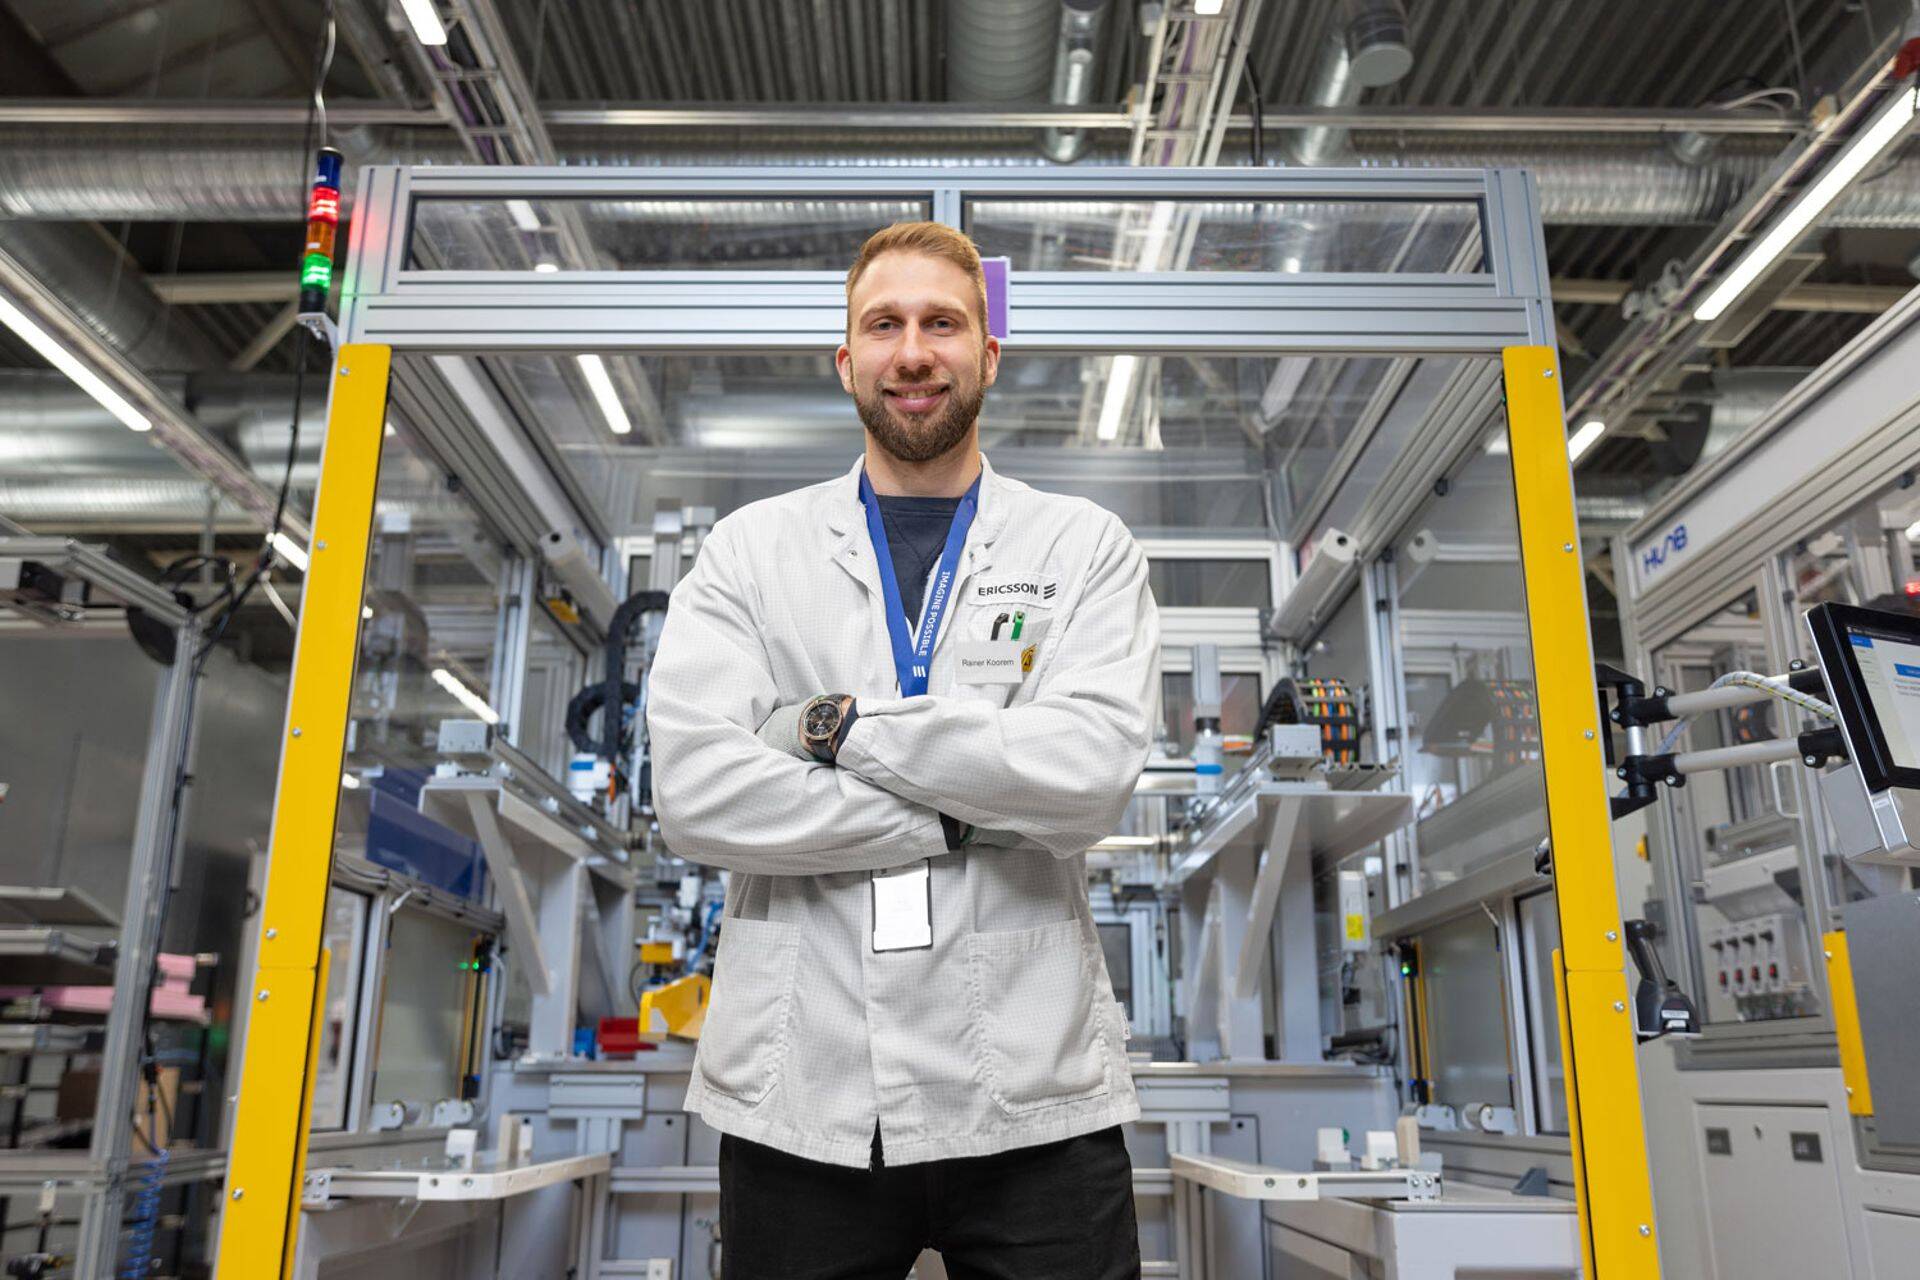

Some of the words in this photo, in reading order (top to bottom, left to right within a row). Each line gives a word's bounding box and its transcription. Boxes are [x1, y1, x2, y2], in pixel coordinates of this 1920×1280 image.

[931, 571, 951, 610] IMAGINE
[978, 582, 1039, 597] ERICSSON
[918, 612, 938, 656] POSSIBLE
[961, 658, 985, 667] Rainer
[986, 658, 1014, 667] Koorem
